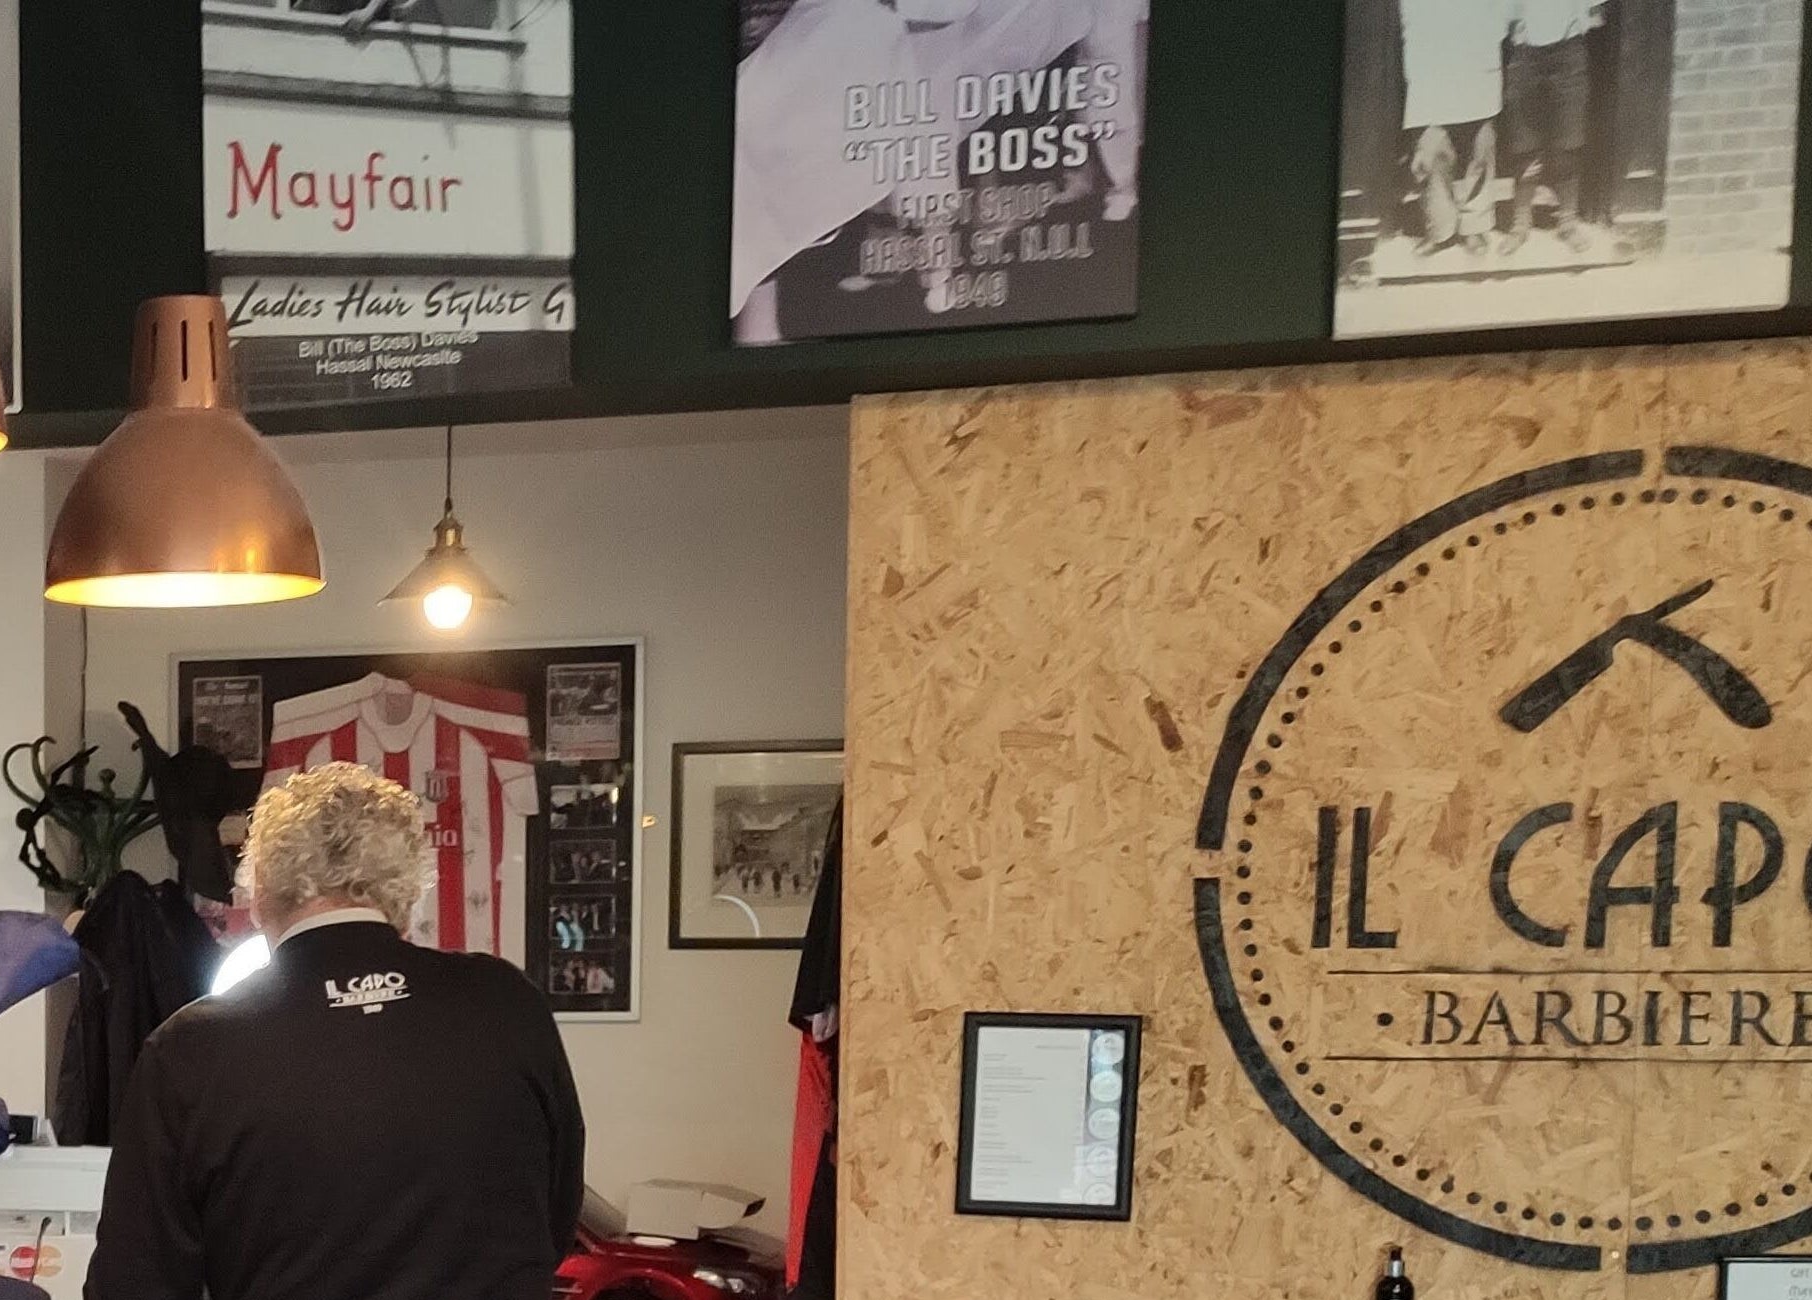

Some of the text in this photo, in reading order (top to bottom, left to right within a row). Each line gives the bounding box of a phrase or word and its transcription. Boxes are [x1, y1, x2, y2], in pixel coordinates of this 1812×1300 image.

[844, 63, 1120, 131] BILL DAVIES
[225, 140, 463, 232] Mayfair
[899, 182, 1056, 229] FIRST SHOP
[859, 230, 964, 275] HASSAL
[230, 279, 324, 328] Ladies
[334, 282, 413, 322] Hair
[424, 280, 531, 326] Stylist
[298, 330, 479, 360] Bill (The Boss) Davies
[316, 356, 373, 376] Hassal
[1310, 800, 1812, 950] IL CAP
